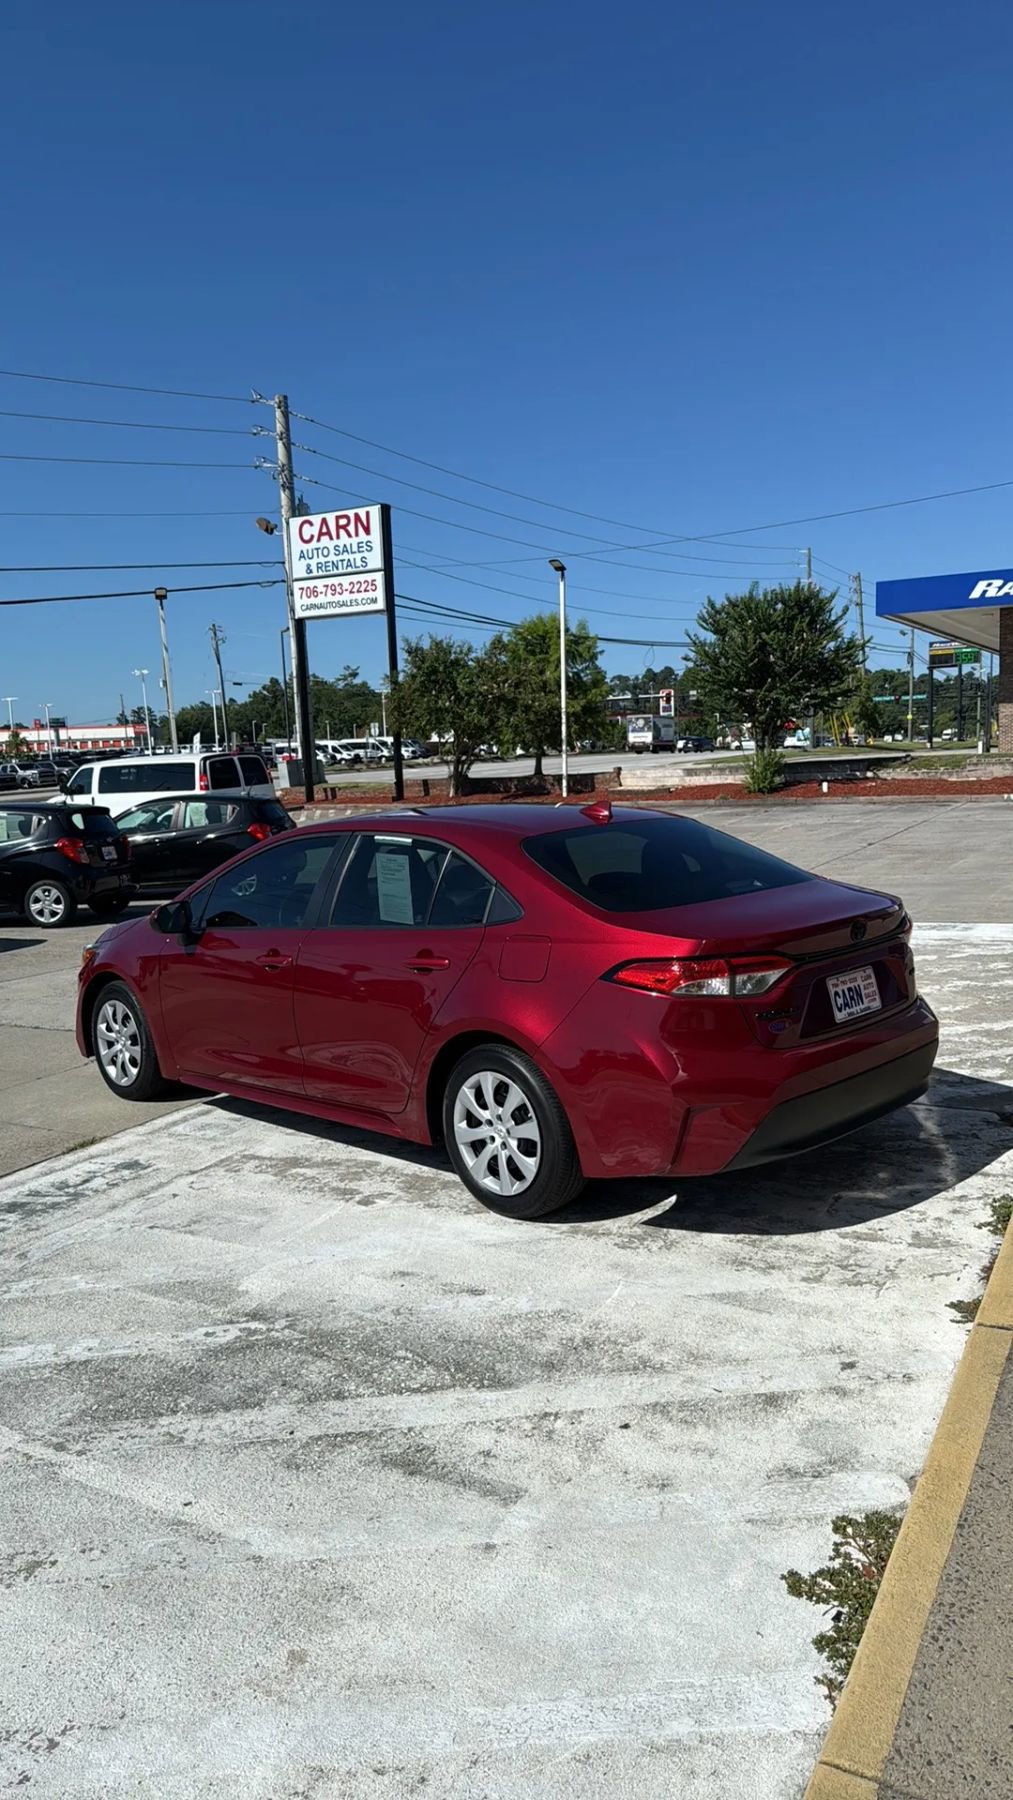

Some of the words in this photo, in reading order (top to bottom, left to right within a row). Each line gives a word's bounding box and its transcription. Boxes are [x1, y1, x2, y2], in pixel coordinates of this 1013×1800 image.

[298, 511, 371, 544] CARN
[298, 546, 330, 561] AUTO
[333, 540, 373, 557] SALES
[305, 563, 313, 575] &
[316, 556, 368, 573] RENTALS
[298, 579, 378, 600] 706-793-2225
[300, 596, 378, 612] CARNAUTOSALES.COM
[834, 984, 864, 1013] CARN
